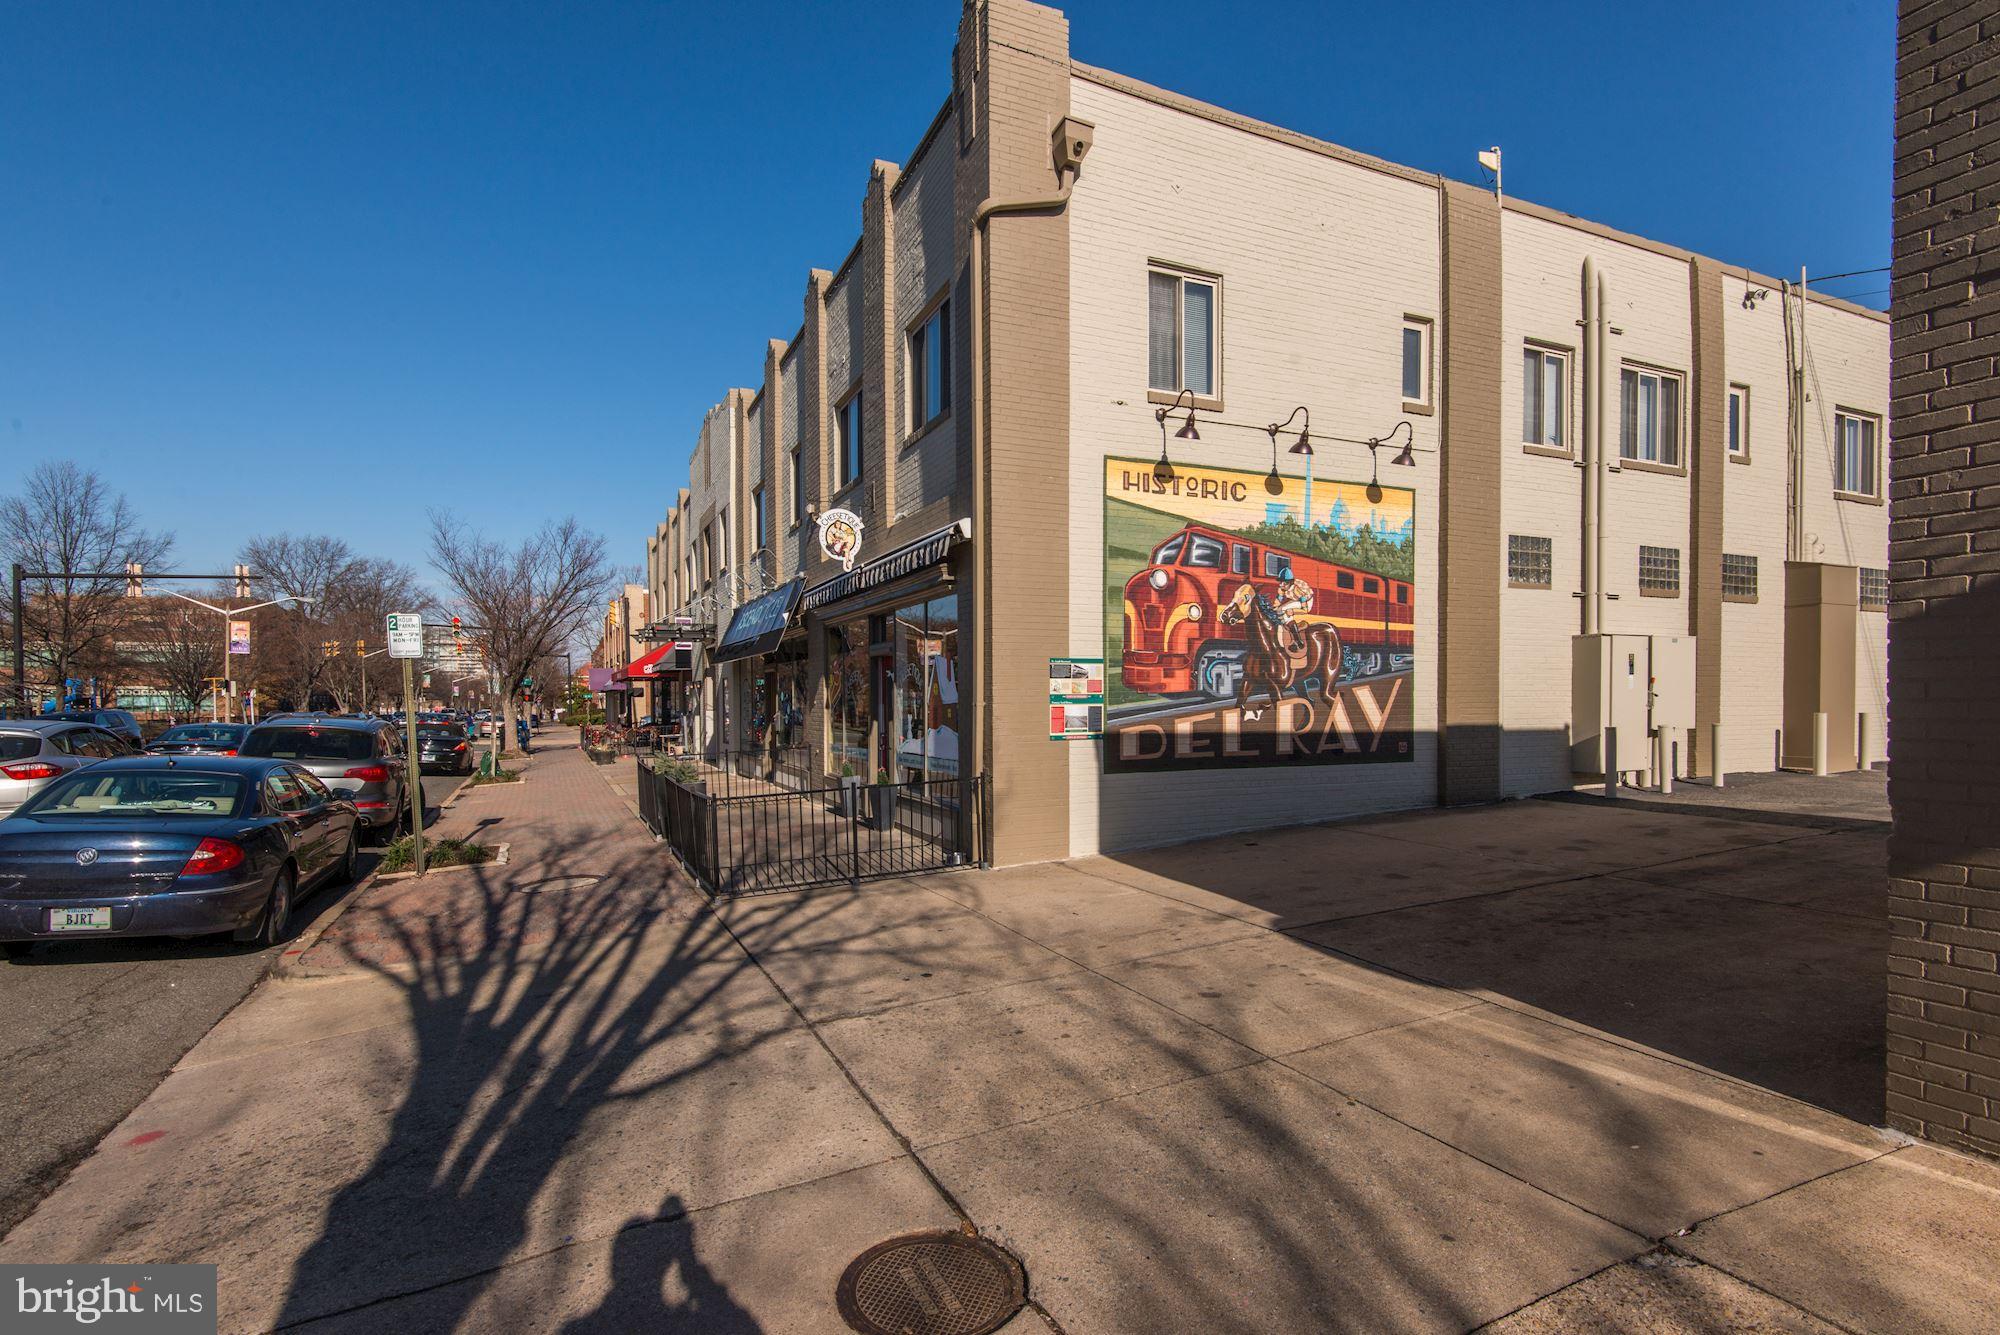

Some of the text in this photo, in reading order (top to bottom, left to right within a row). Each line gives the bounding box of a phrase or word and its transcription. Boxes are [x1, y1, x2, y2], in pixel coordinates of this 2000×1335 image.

[1123, 471, 1247, 501] HISTORIC
[390, 618, 397, 628] 2
[1119, 678, 1402, 760] DEL RAY
[66, 913, 94, 925] BJRT
